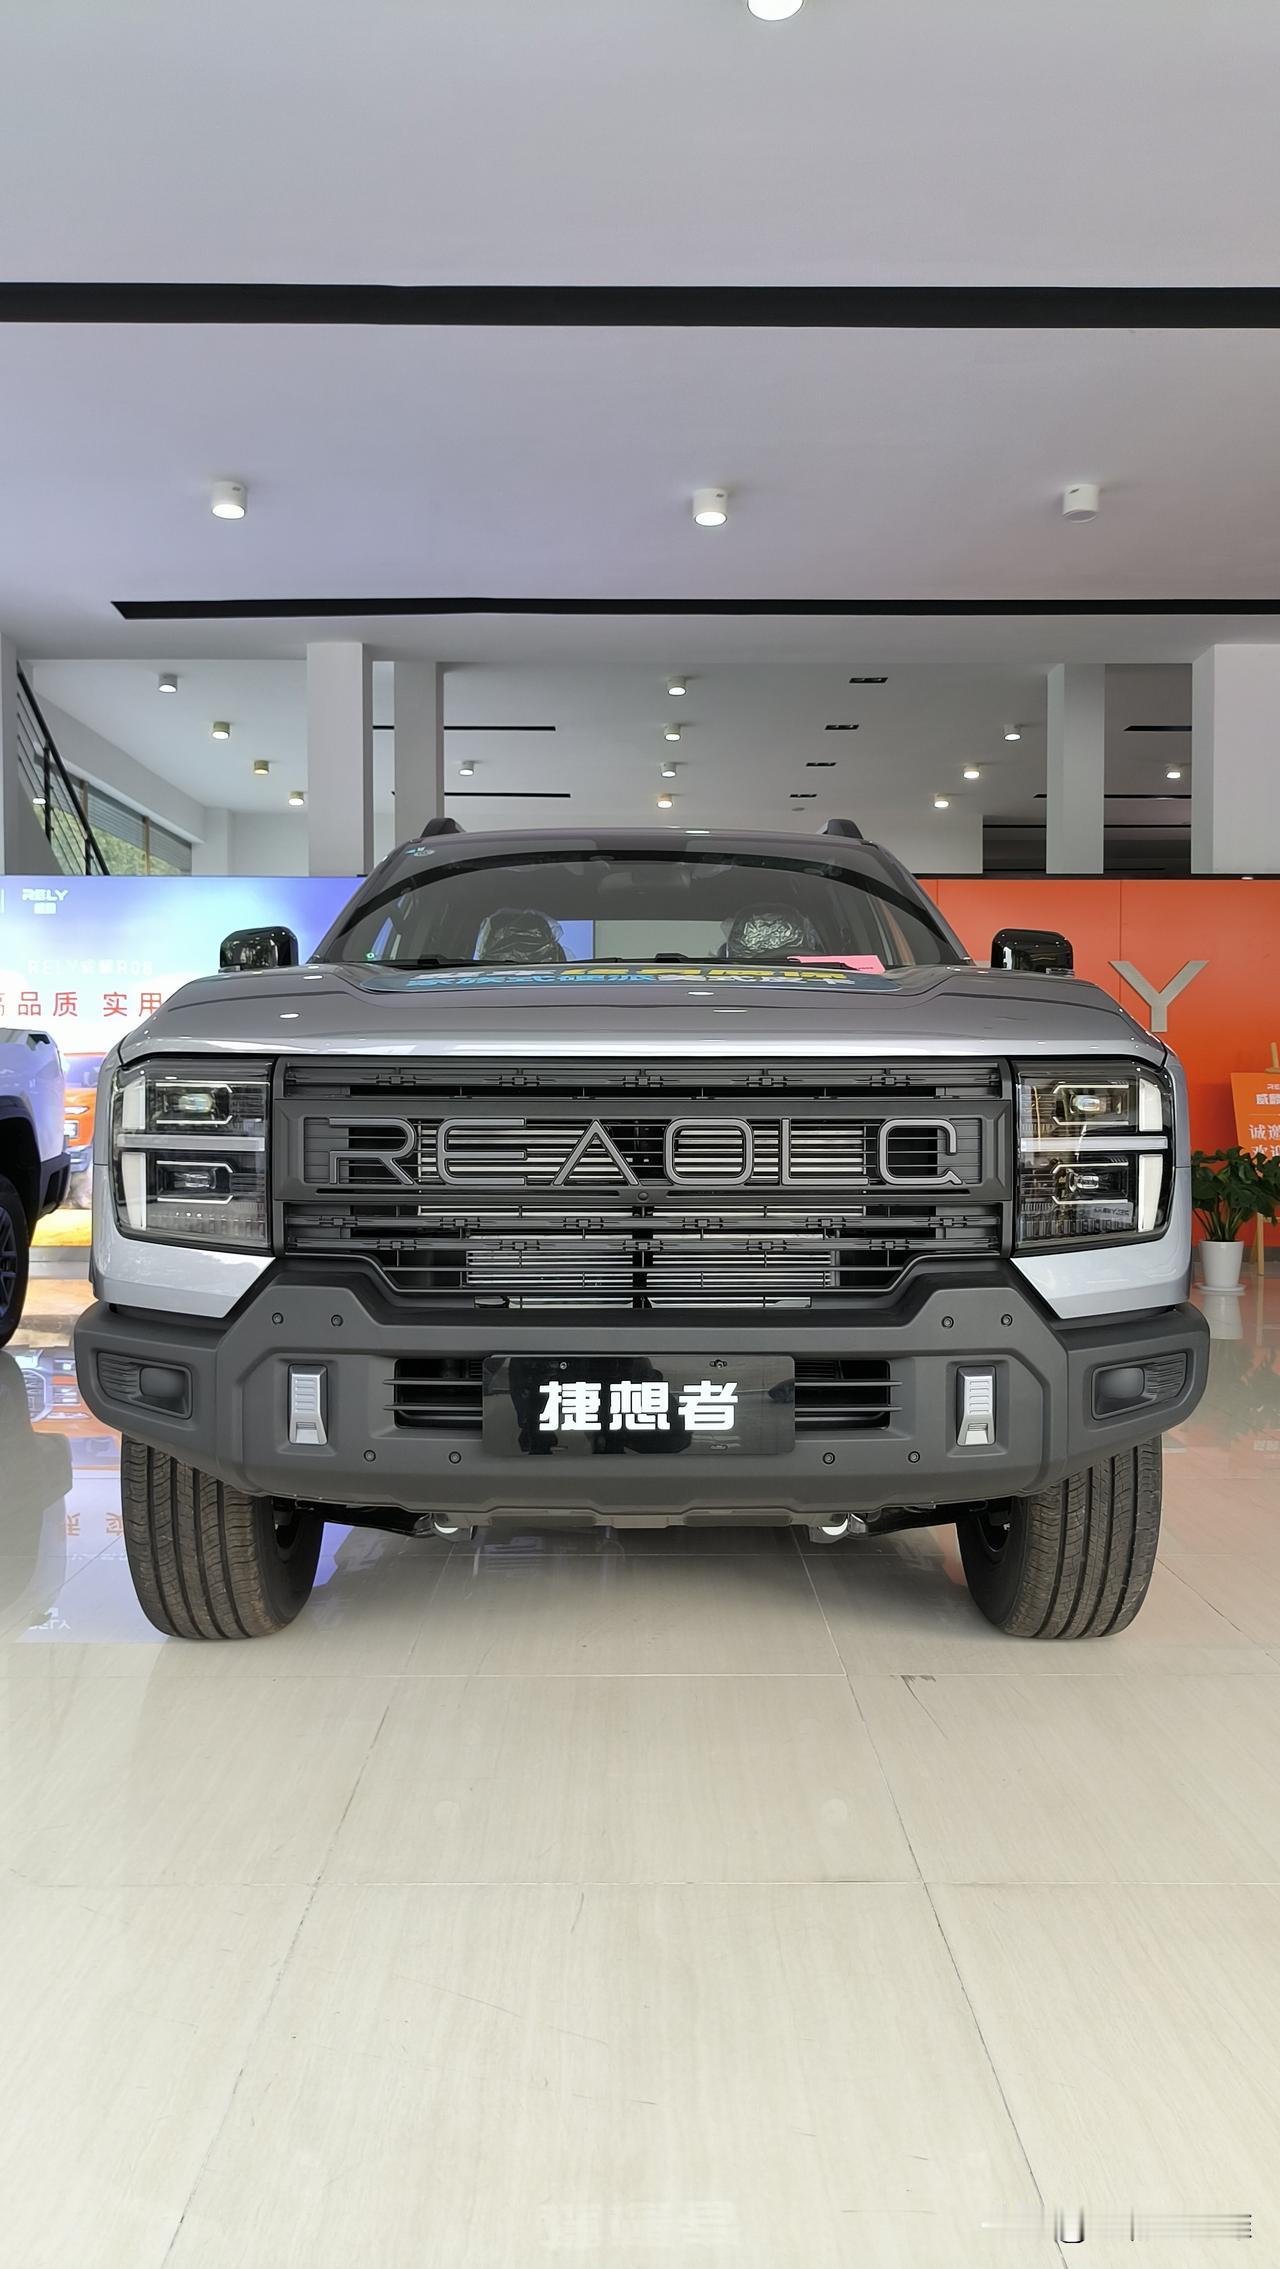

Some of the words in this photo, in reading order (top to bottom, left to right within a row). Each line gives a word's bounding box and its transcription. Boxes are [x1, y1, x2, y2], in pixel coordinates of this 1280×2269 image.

[21, 888, 69, 901] RELY
[0, 991, 78, 1017] 品质
[103, 991, 162, 1017] 实用
[1108, 960, 1210, 1032] Y
[539, 1380, 739, 1431] 捷想者
